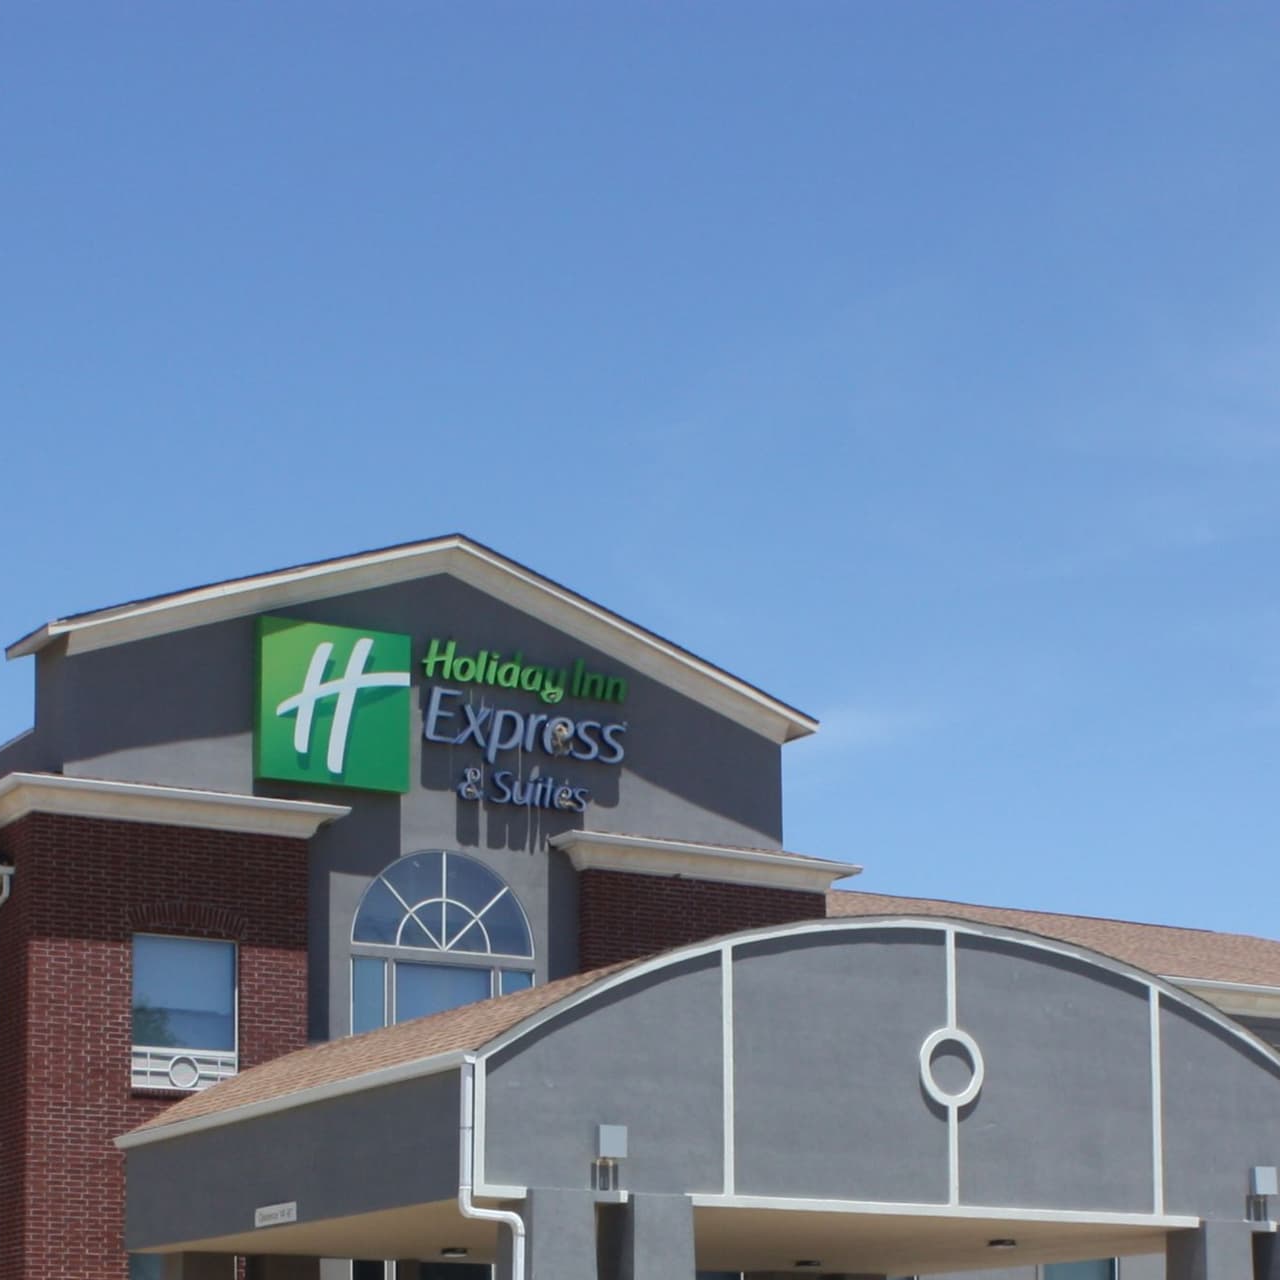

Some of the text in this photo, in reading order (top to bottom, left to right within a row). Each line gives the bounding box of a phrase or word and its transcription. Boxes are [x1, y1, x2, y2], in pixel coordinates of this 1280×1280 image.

[422, 638, 628, 704] Holiday Inn
[424, 686, 626, 764] Express
[457, 767, 590, 812] & Suites
